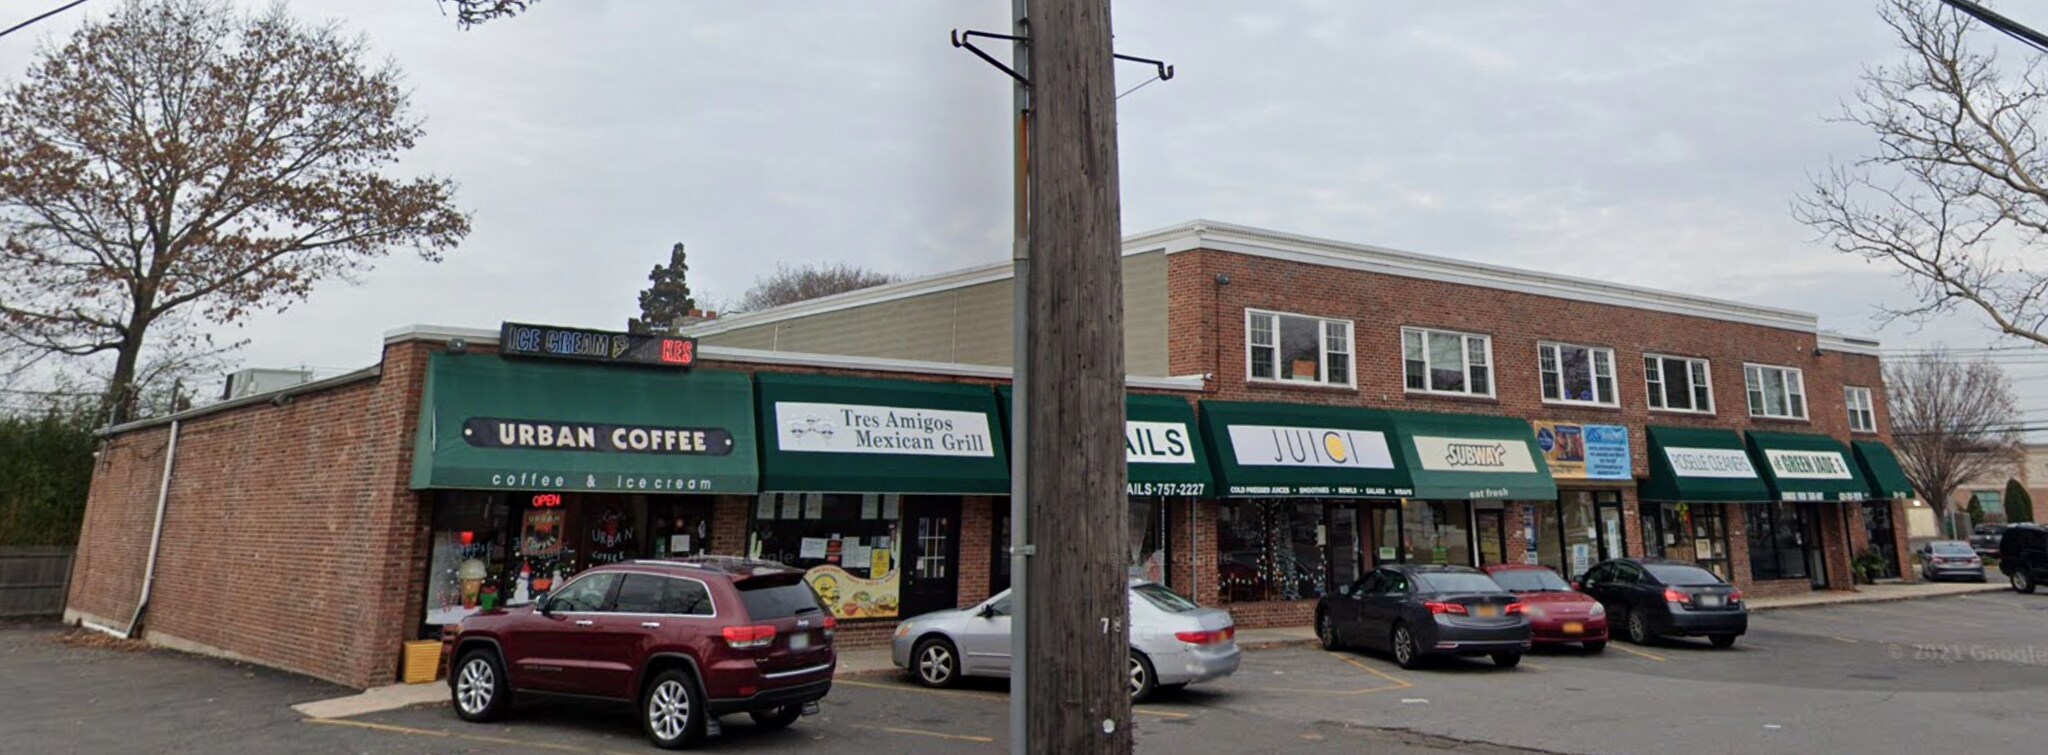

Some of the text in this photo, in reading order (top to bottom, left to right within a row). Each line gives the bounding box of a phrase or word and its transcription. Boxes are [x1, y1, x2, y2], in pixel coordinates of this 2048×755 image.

[507, 327, 609, 357] ICE CREAM
[840, 409, 953, 434] Tres Amigos
[499, 423, 706, 451] URBAN COFFEE
[855, 430, 985, 452] Mexican Grill
[1272, 429, 1359, 464] JUICI
[1446, 443, 1506, 467] SUBWAY
[1781, 455, 1815, 473] GREEN
[1811, 456, 1838, 474] JADE
[492, 473, 564, 487] coffee
[586, 474, 596, 487] &
[532, 494, 560, 506] OPEN
[1230, 486, 1246, 494] COLD
[1246, 486, 1270, 494] PRESSED
[1394, 488, 1412, 496] WRAPS
[1469, 488, 1509, 499] eat fresh
[592, 527, 634, 548] URBAN
